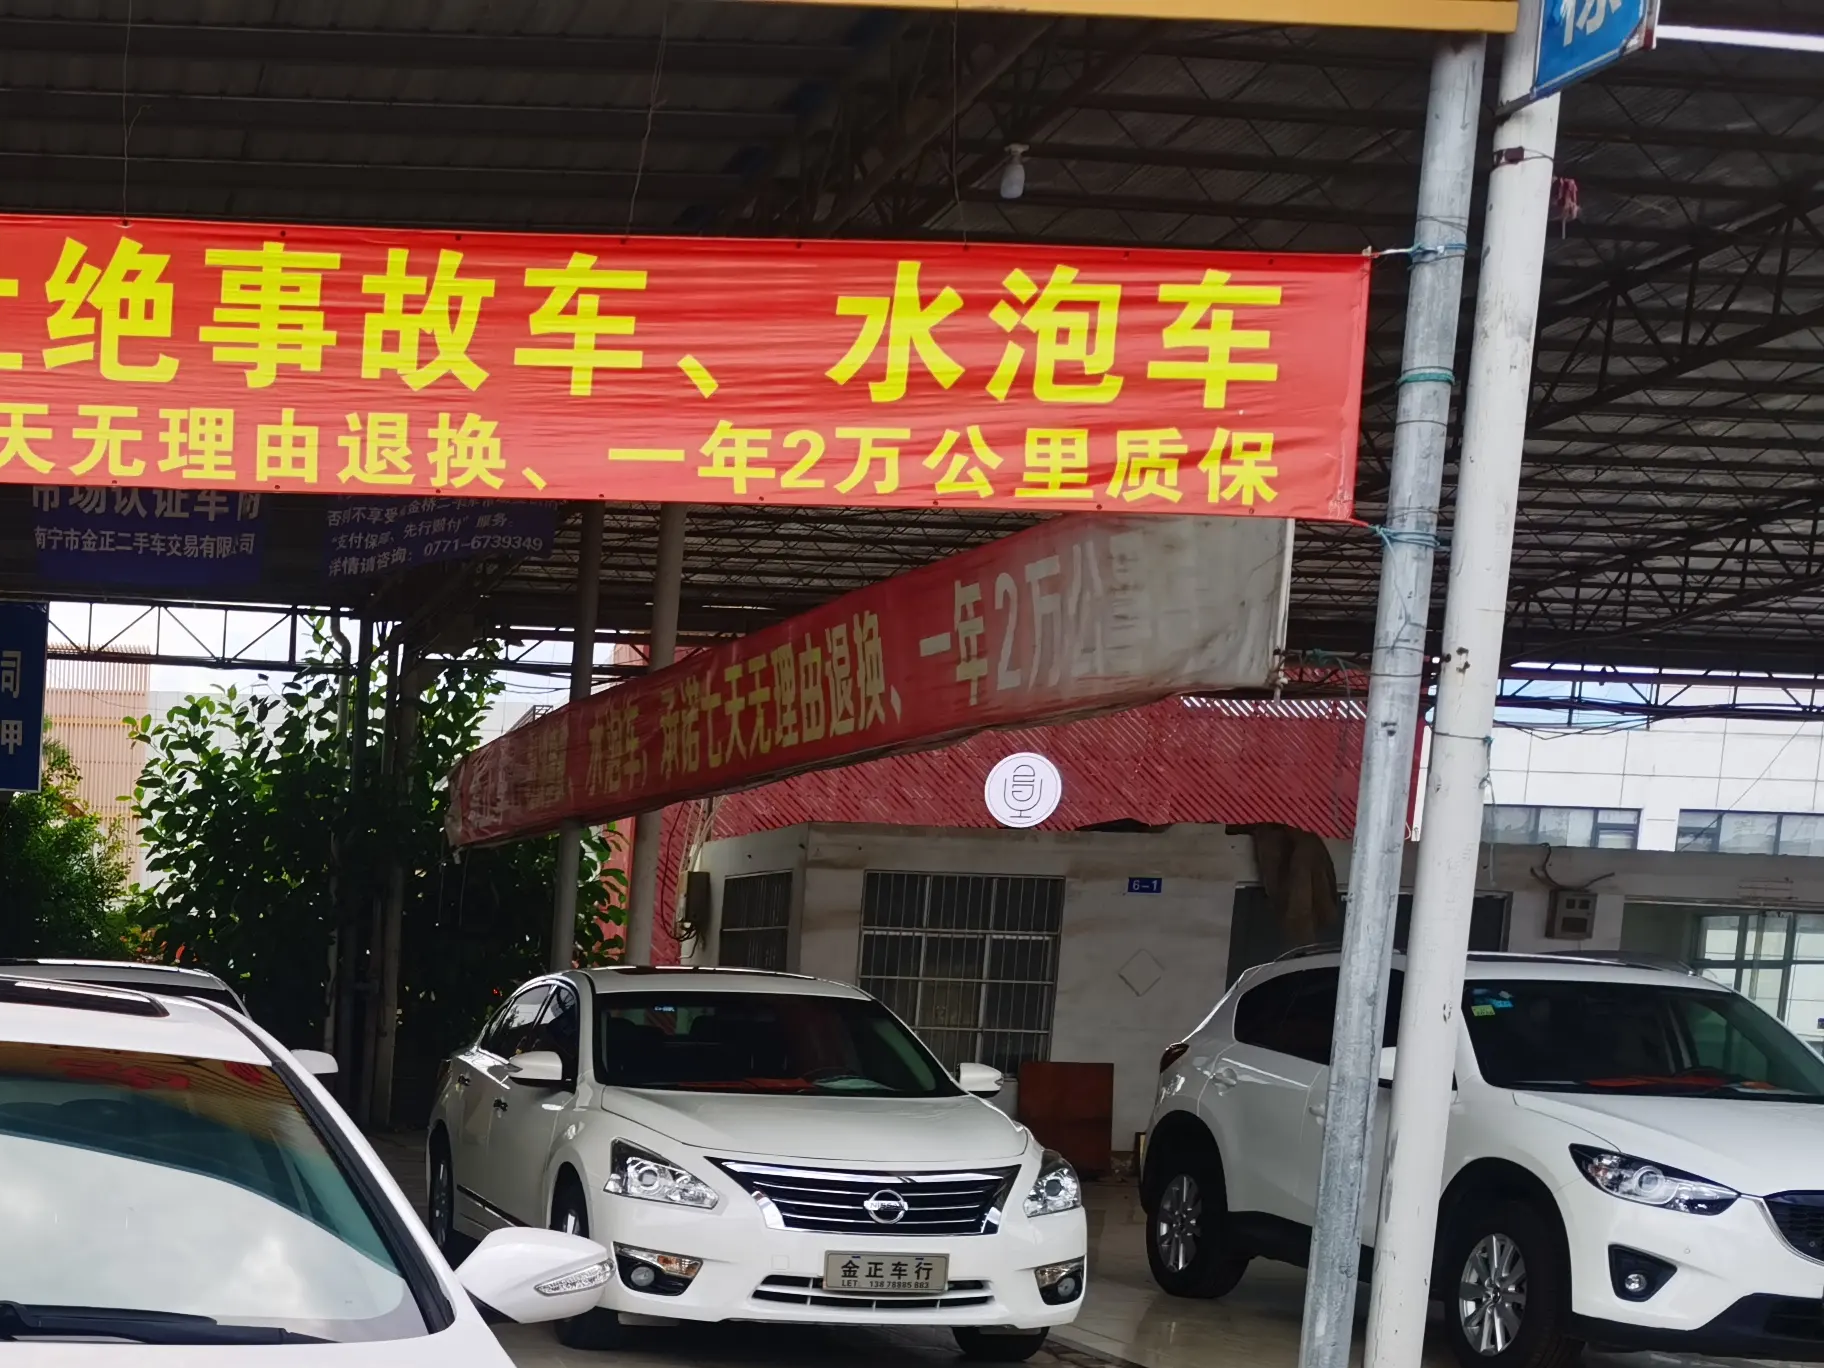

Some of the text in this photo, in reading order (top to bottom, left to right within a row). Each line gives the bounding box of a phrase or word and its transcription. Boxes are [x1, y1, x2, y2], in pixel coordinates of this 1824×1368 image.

[1132, 879, 1158, 891] 6-1
[841, 1259, 933, 1281] 金正车行
